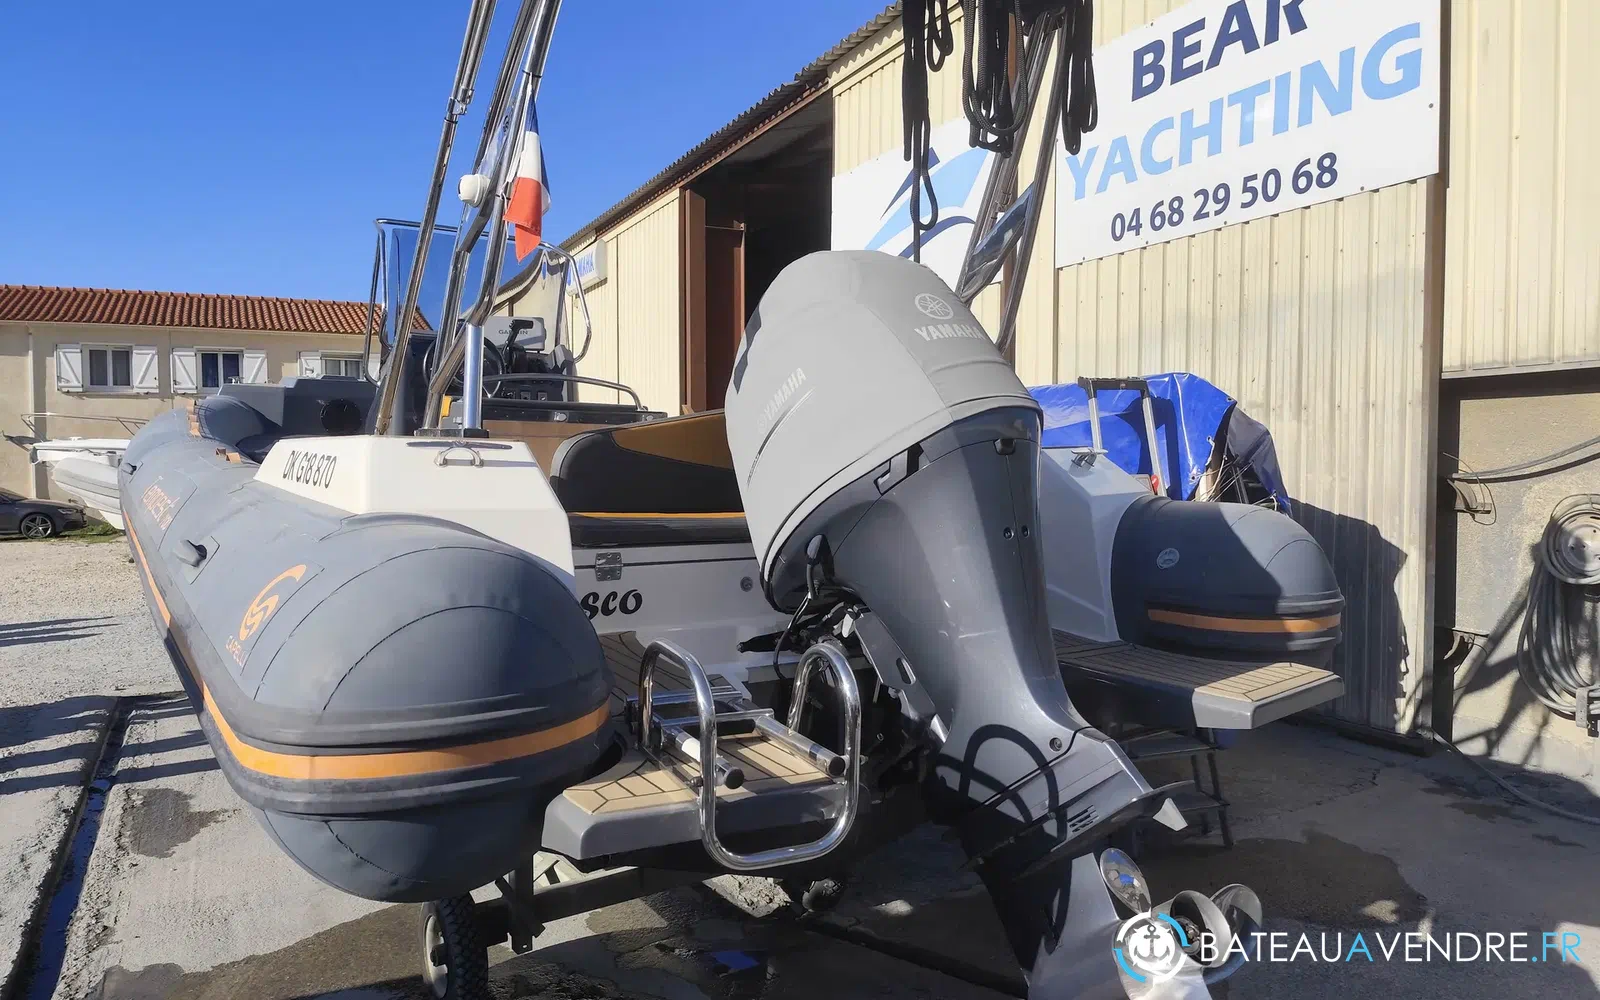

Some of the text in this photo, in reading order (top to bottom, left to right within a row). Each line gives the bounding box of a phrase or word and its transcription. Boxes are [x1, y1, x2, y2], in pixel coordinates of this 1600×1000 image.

[1132, 0, 1307, 102] BEAR
[1065, 22, 1423, 201] YACHTING
[1111, 151, 1339, 242] 04 68 29 50 68
[914, 323, 987, 341] YAMAHA
[764, 367, 807, 421] YAMAHA
